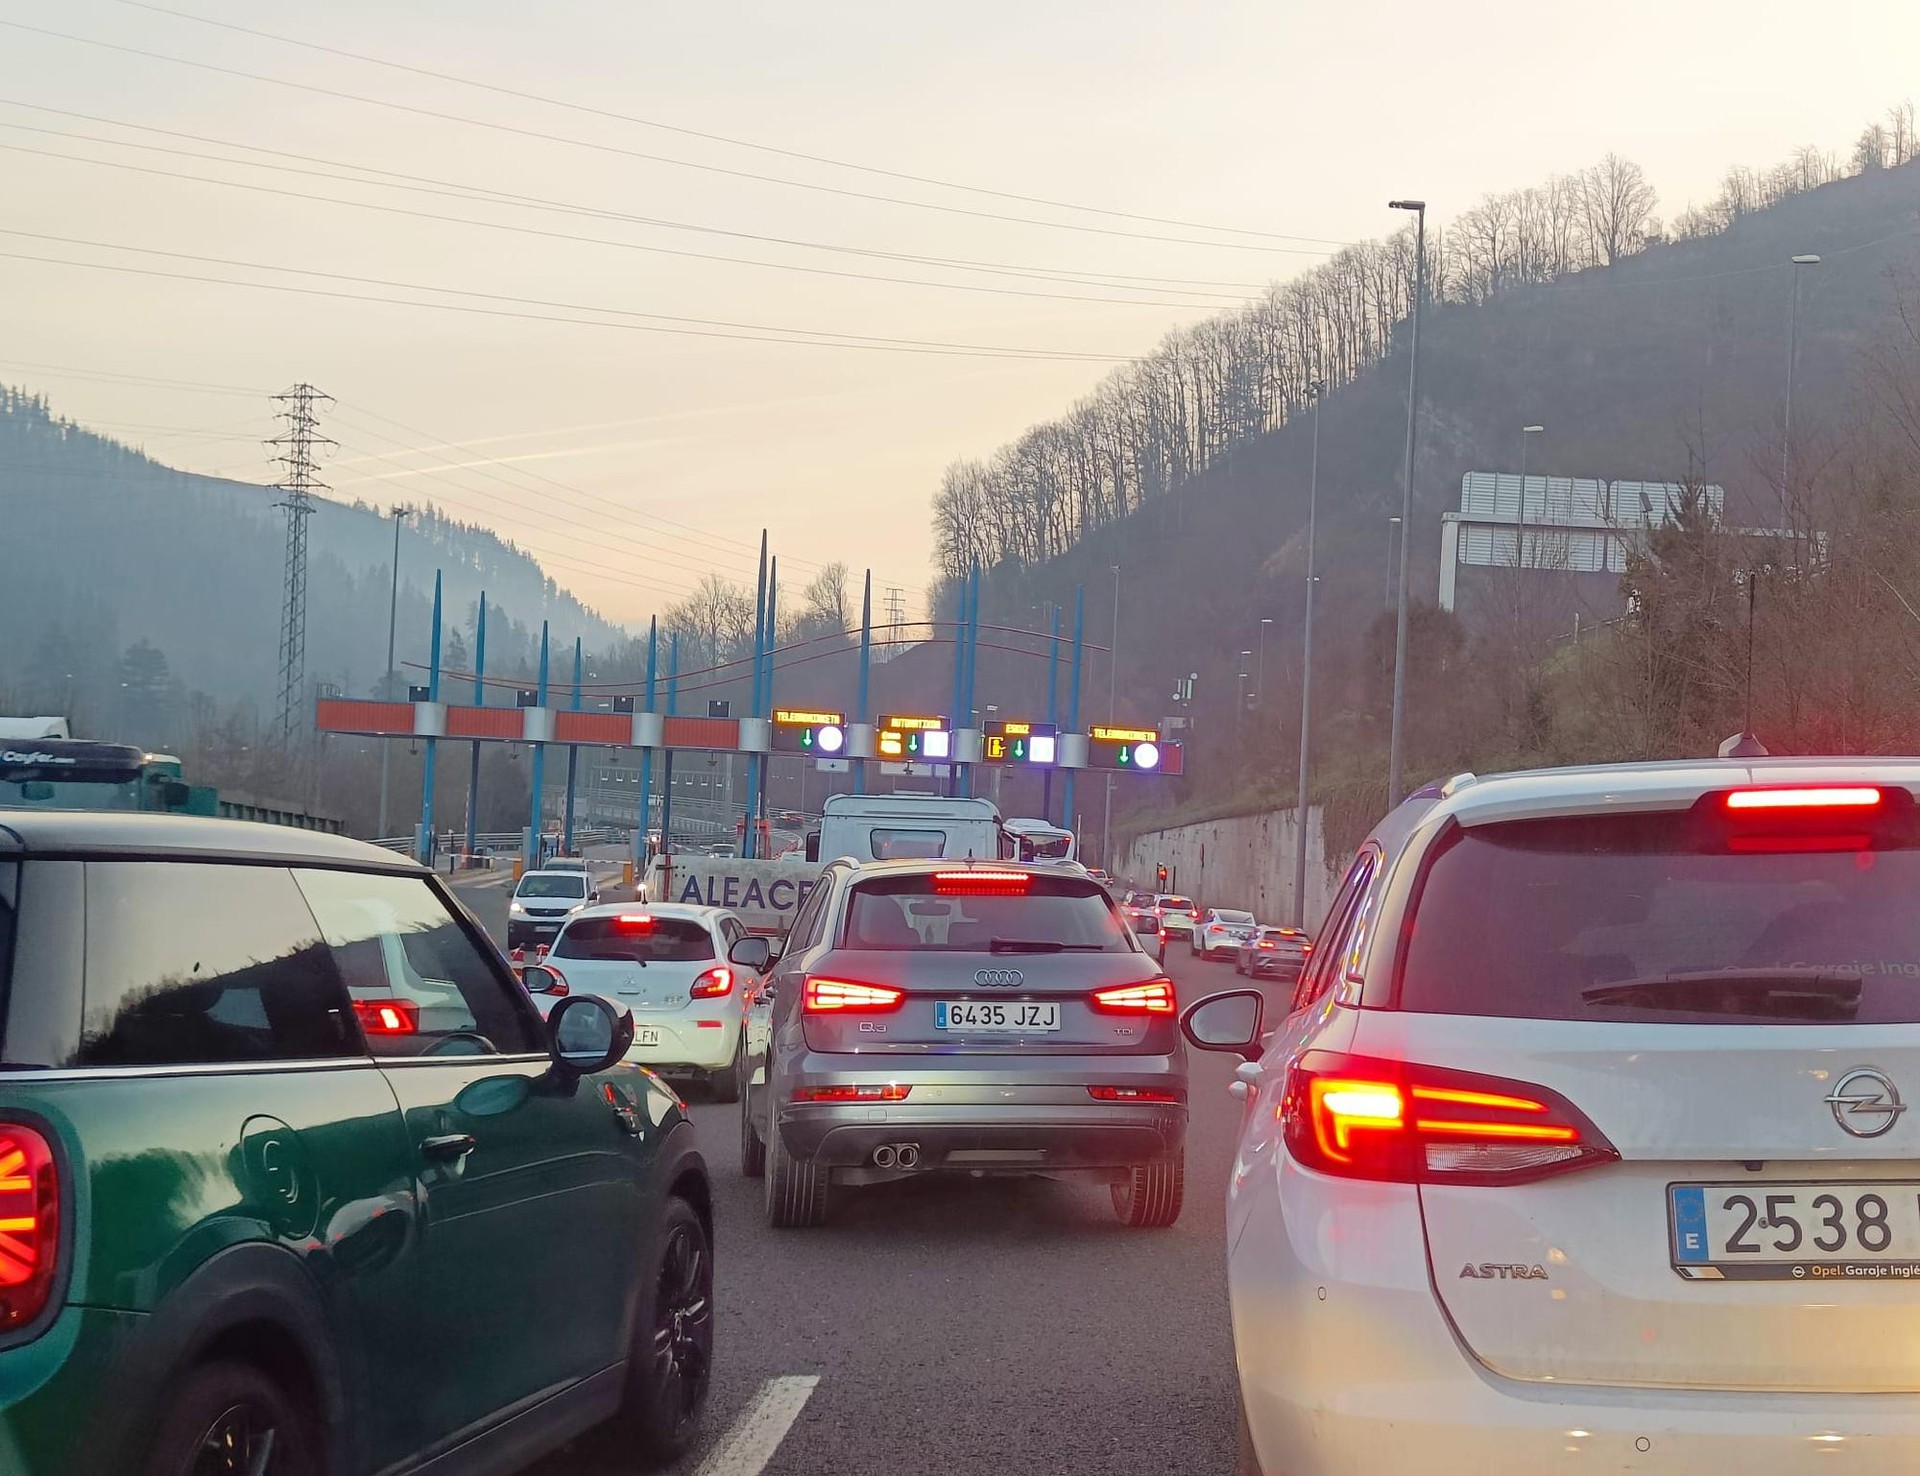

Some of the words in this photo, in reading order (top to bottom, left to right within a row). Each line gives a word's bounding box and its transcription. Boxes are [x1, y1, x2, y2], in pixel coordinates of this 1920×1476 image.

[1880, 960, 1920, 979] Ing
[951, 1005, 1005, 1025] 6435
[1014, 1006, 1055, 1026] JZJ
[859, 1021, 887, 1033] Q3
[1114, 1028, 1133, 1036] TDI
[635, 1030, 658, 1043] LFN
[1685, 1233, 1700, 1249] E
[1722, 1194, 1892, 1253] 2538
[1459, 1262, 1549, 1280] ASTRA
